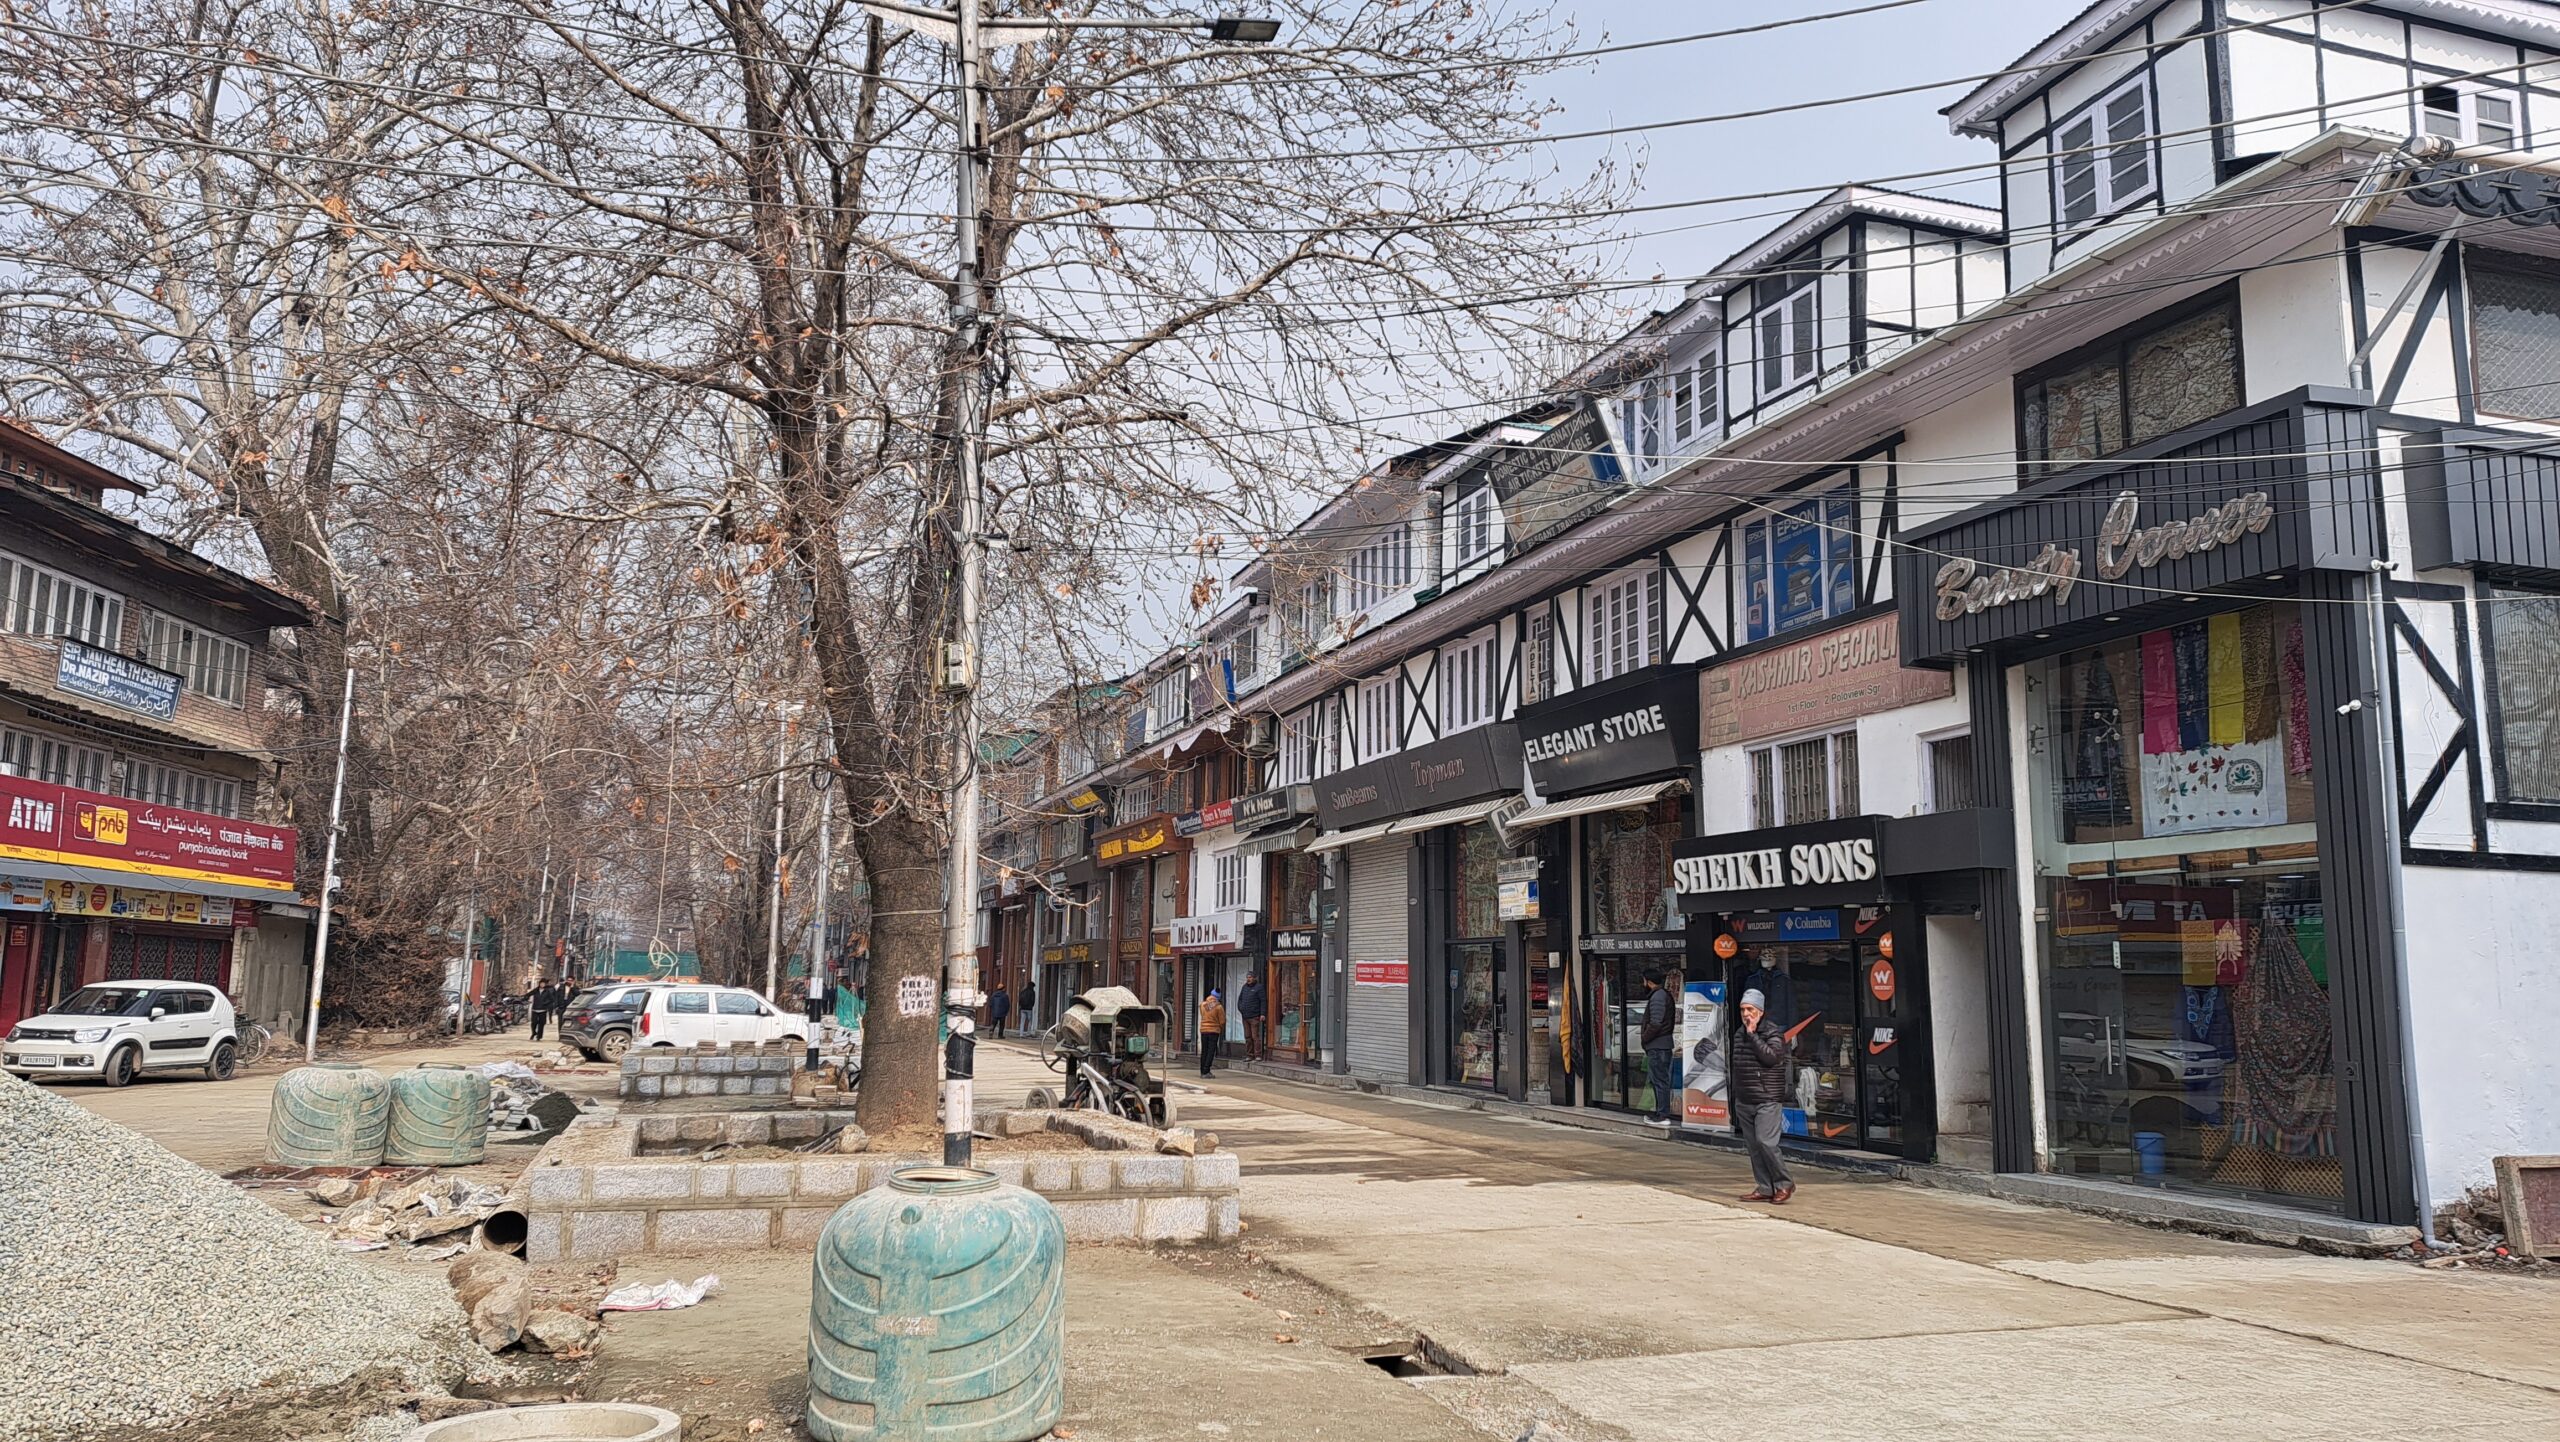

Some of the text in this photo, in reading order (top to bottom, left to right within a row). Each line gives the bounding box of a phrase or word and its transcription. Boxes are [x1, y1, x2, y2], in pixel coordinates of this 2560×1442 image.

[1494, 454, 1530, 482] DOMESTIC
[1535, 411, 1595, 452] INTERNATIONAL
[1508, 433, 1593, 492] AIR TICKETS AVAILABLE
[1777, 507, 1817, 537] EPSON
[1746, 529, 1765, 543] EPSON
[1934, 491, 2273, 621] Beauty Corner
[102, 652, 140, 682] HEALTH
[139, 666, 176, 693] CENTRE
[1737, 645, 1813, 699] KASHMIR
[1788, 703, 1798, 714] 1st
[1800, 700, 1818, 711] Floor
[1832, 688, 1866, 702] Poloview
[1524, 704, 1666, 763] ELEGANT STORE
[1410, 757, 1465, 792] Topman
[1257, 797, 1274, 813] Nax
[1331, 784, 1378, 811] SunBeams
[8, 796, 54, 833] ATM
[99, 812, 125, 837] pnb
[1497, 799, 1528, 829] AIR
[178, 841, 204, 856] punjab
[204, 843, 231, 859] national
[231, 847, 248, 861] bank
[1673, 838, 1876, 894] SHEIKH SONS
[1747, 921, 1775, 931] WILDCRAFT
[1795, 916, 1832, 930] Columbia
[1858, 906, 1879, 921] NIKE
[1277, 932, 1311, 949] Nik Nax
[1580, 939, 1598, 950] ELEGANT
[1600, 938, 1615, 950] STORE
[1873, 1027, 1894, 1043] NIKE
